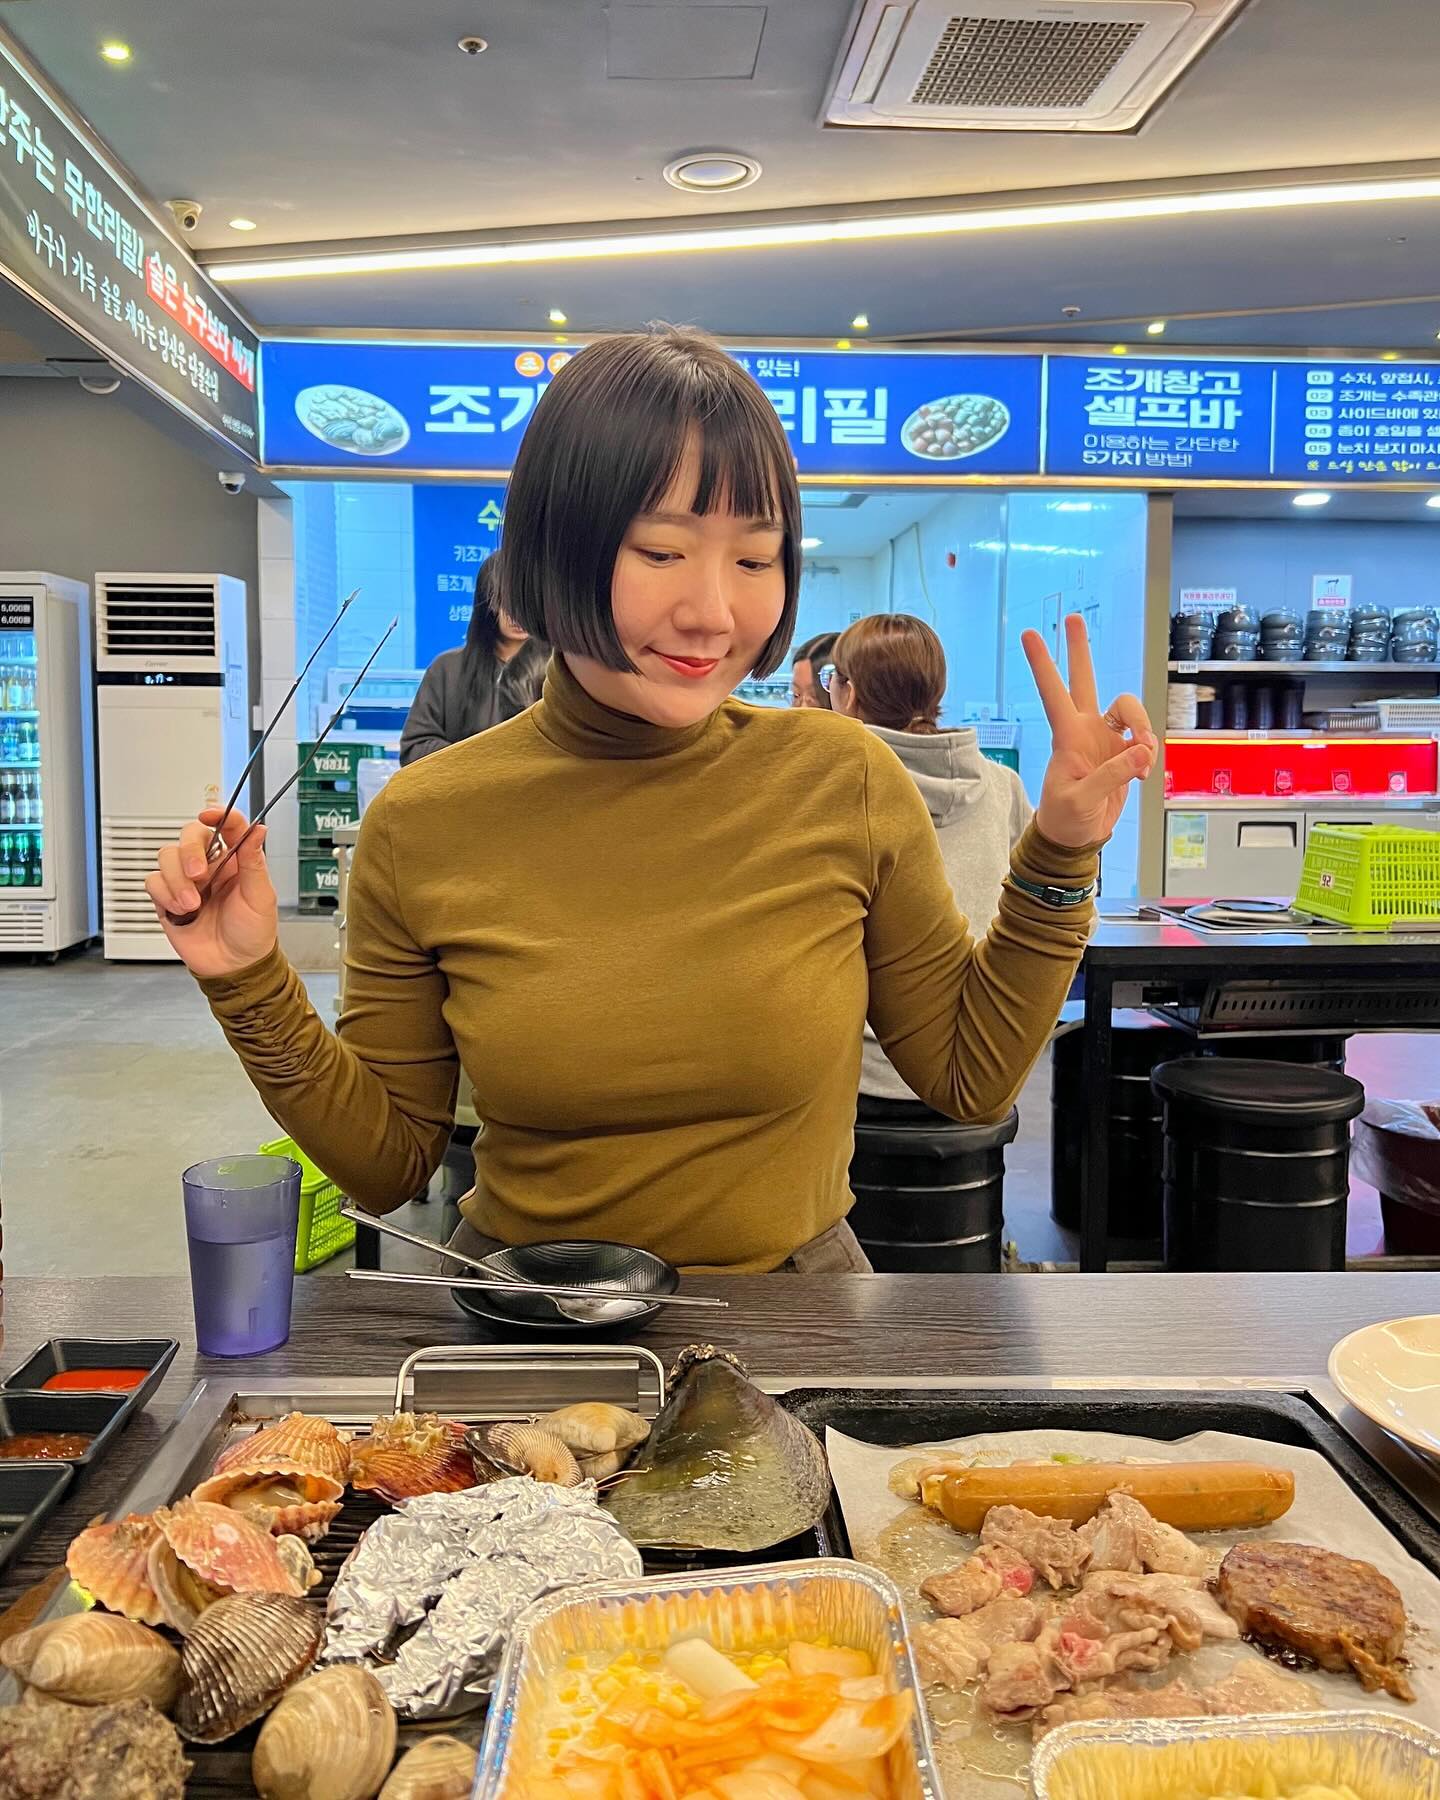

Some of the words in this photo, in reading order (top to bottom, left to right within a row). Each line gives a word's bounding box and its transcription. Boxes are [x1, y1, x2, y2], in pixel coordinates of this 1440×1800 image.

[64, 157, 144, 280] 무한리필!
[149, 250, 179, 313] 술은
[182, 281, 228, 363] 누구보다
[26, 208, 67, 277] 바구니
[71, 250, 97, 303] 가득
[100, 275, 123, 322] 술을
[125, 298, 157, 352] 채우는
[158, 325, 188, 377] 당신은
[187, 351, 218, 403] 단골손님
[756, 357, 801, 378] 있는!
[1083, 367, 1243, 395] 조개창고
[1339, 371, 1377, 386] 수저,
[1338, 390, 1388, 402] 조개는
[1391, 390, 1440, 403] 수족관
[1083, 394, 1243, 430] 셀프바
[1338, 407, 1419, 420] 사이드바에
[1083, 433, 1169, 451] 이용하는
[1175, 436, 1240, 453] 간단한
[1338, 442, 1370, 455] 눈치
[1373, 442, 1406, 455] 보지
[1082, 449, 1142, 466] 5가지
[1145, 452, 1193, 468] 방법!
[313, 757, 351, 773] TERRA
